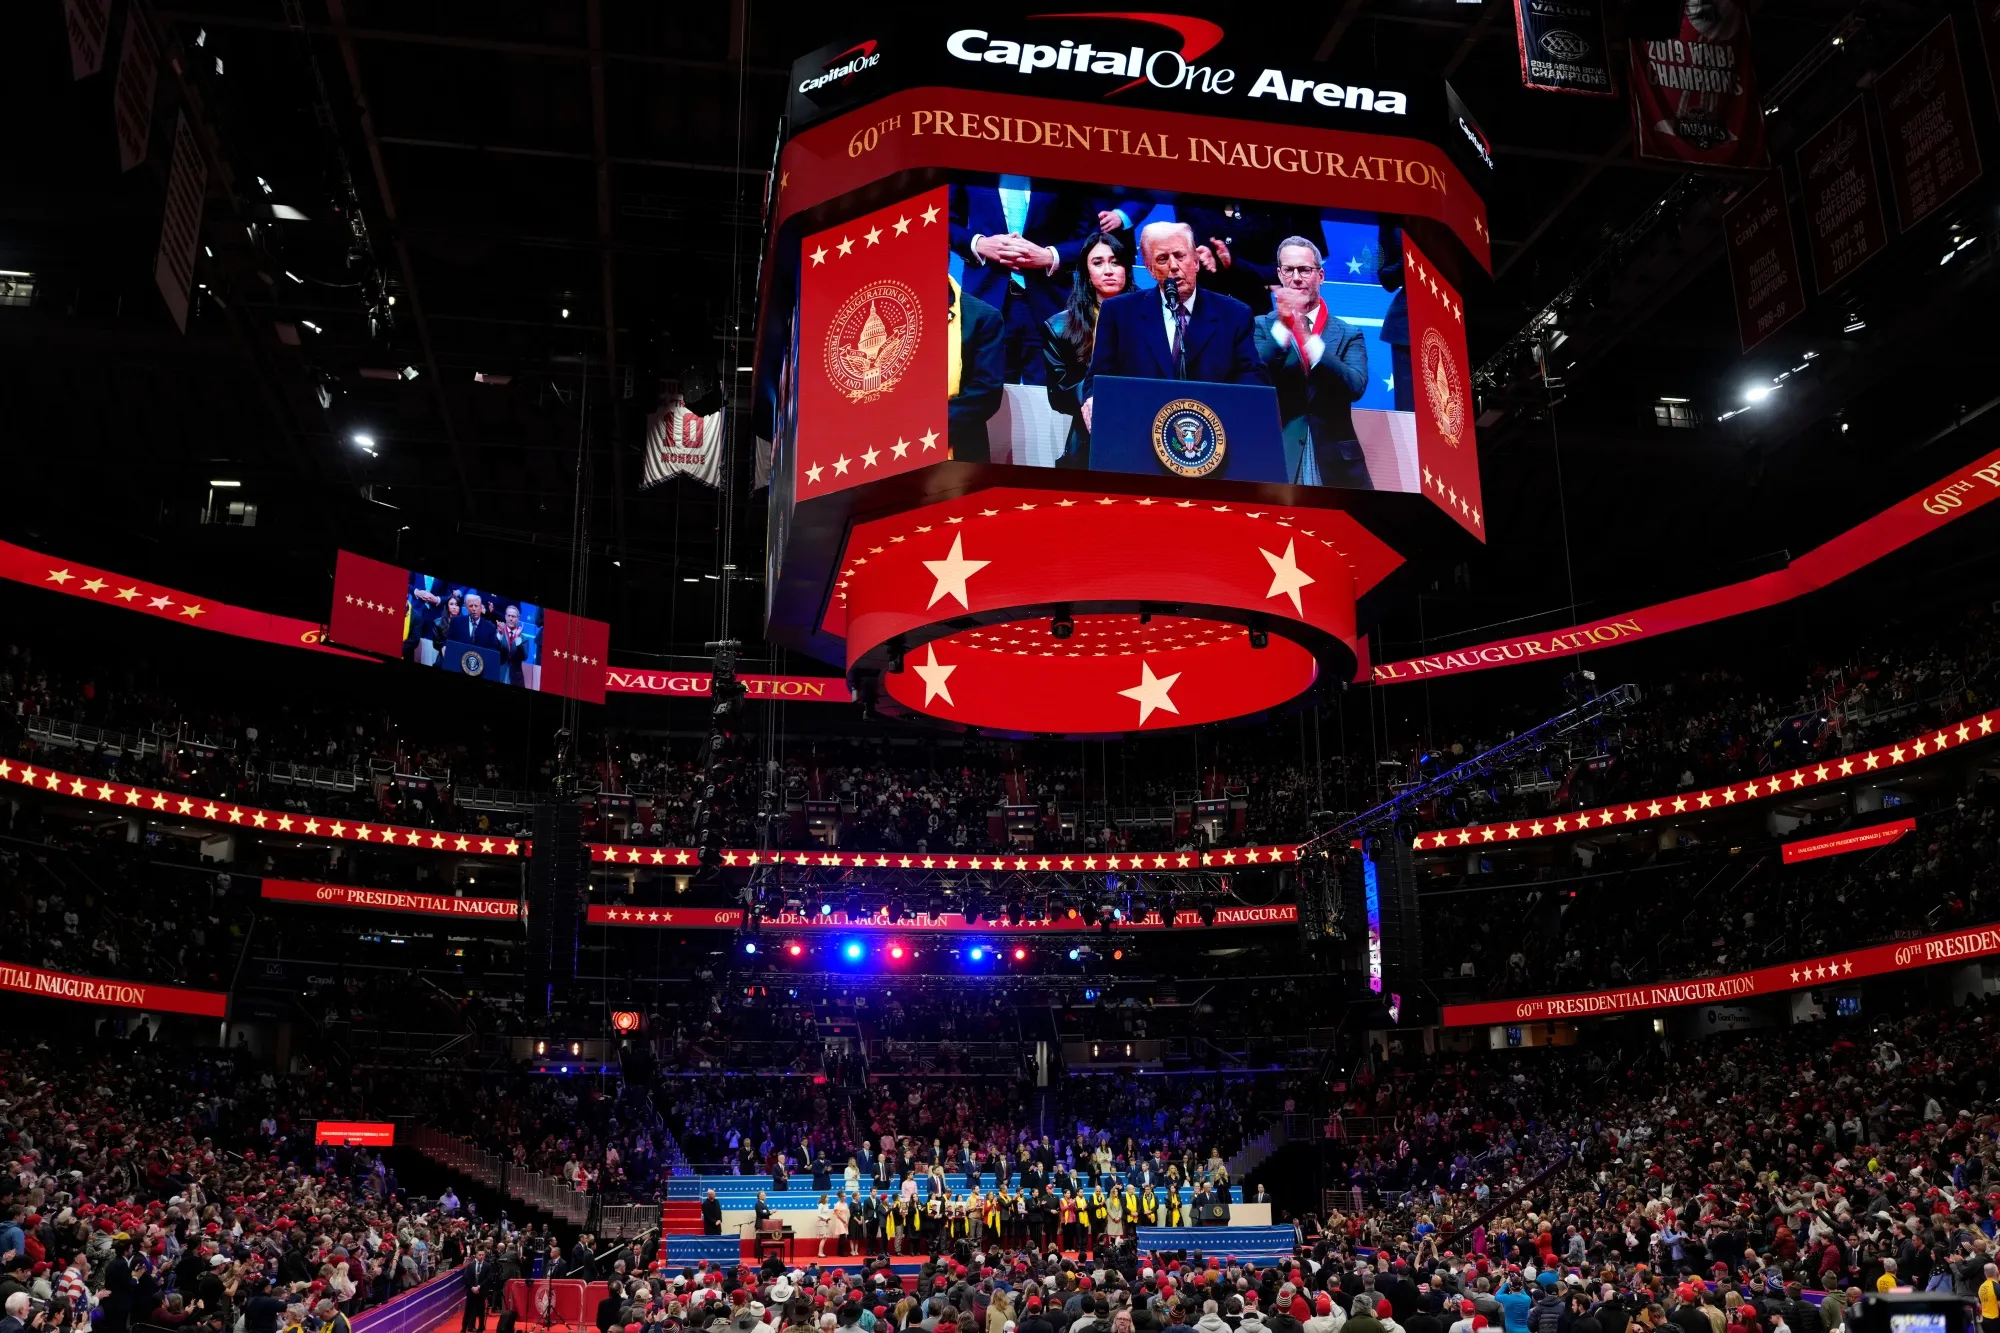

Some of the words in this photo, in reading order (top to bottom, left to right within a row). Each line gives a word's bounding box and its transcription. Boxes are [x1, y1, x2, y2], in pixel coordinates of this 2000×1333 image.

[1554, 63, 1581, 73] ARENA
[1582, 66, 1606, 76] BOWL
[1648, 39, 1686, 64] 2019
[1688, 41, 1736, 69] WNBA
[1247, 69, 1407, 115] Arena
[1531, 67, 1607, 85] CHAMPIONS
[1648, 61, 1744, 97] CHAMPIONS
[1900, 91, 1947, 140] SOUTHEAST
[1908, 110, 1945, 149] DIVISION
[847, 114, 902, 160] 60TH
[912, 111, 1179, 162] PRESIDENTIAL
[1188, 139, 1448, 196] INAUGURATION
[1905, 120, 1955, 167] CHAMPIONS
[1815, 173, 1867, 225] CONFERENCE
[1820, 166, 1857, 204] EASTERN
[1819, 191, 1867, 238] CHAMPIONS
[1830, 221, 1865, 256] 1997-98
[1832, 237, 1867, 274] 2017-18
[1749, 248, 1777, 276] PATRICK
[1750, 261, 1781, 291] DIVISION
[838, 287, 898, 326] INAUGURATION
[897, 293, 909, 304] OF
[1748, 270, 1788, 310] CHAMPIONS
[830, 335, 847, 380] PRESIDENT
[844, 378, 862, 390] AND
[882, 362, 902, 380] VICE
[664, 411, 704, 449] 10
[1155, 401, 1186, 435] PRESIDENT
[1207, 412, 1224, 445] UNITED
[660, 452, 706, 465] MONROE
[1166, 457, 1185, 474] SEAL
[1196, 451, 1221, 475] STATES
[1923, 480, 1976, 515] 60TH
[1407, 618, 1644, 675] INAUGURATION
[1797, 843, 1830, 853] INAUGURATION
[1835, 836, 1859, 846] PRESIDENT
[1859, 832, 1879, 841] DONALD
[316, 887, 344, 900] 60TH
[347, 889, 450, 911] PRESIDENTIAL
[713, 911, 741, 924] 60TH
[1895, 944, 1922, 966] 60TH
[0, 967, 32, 989] TIAL
[34, 973, 146, 1005] INAUGURATION
[1516, 1001, 1543, 1018] 60TH
[1547, 990, 1649, 1016] PRESIDENTIAL
[1651, 975, 1755, 1004] INAUGURATION
